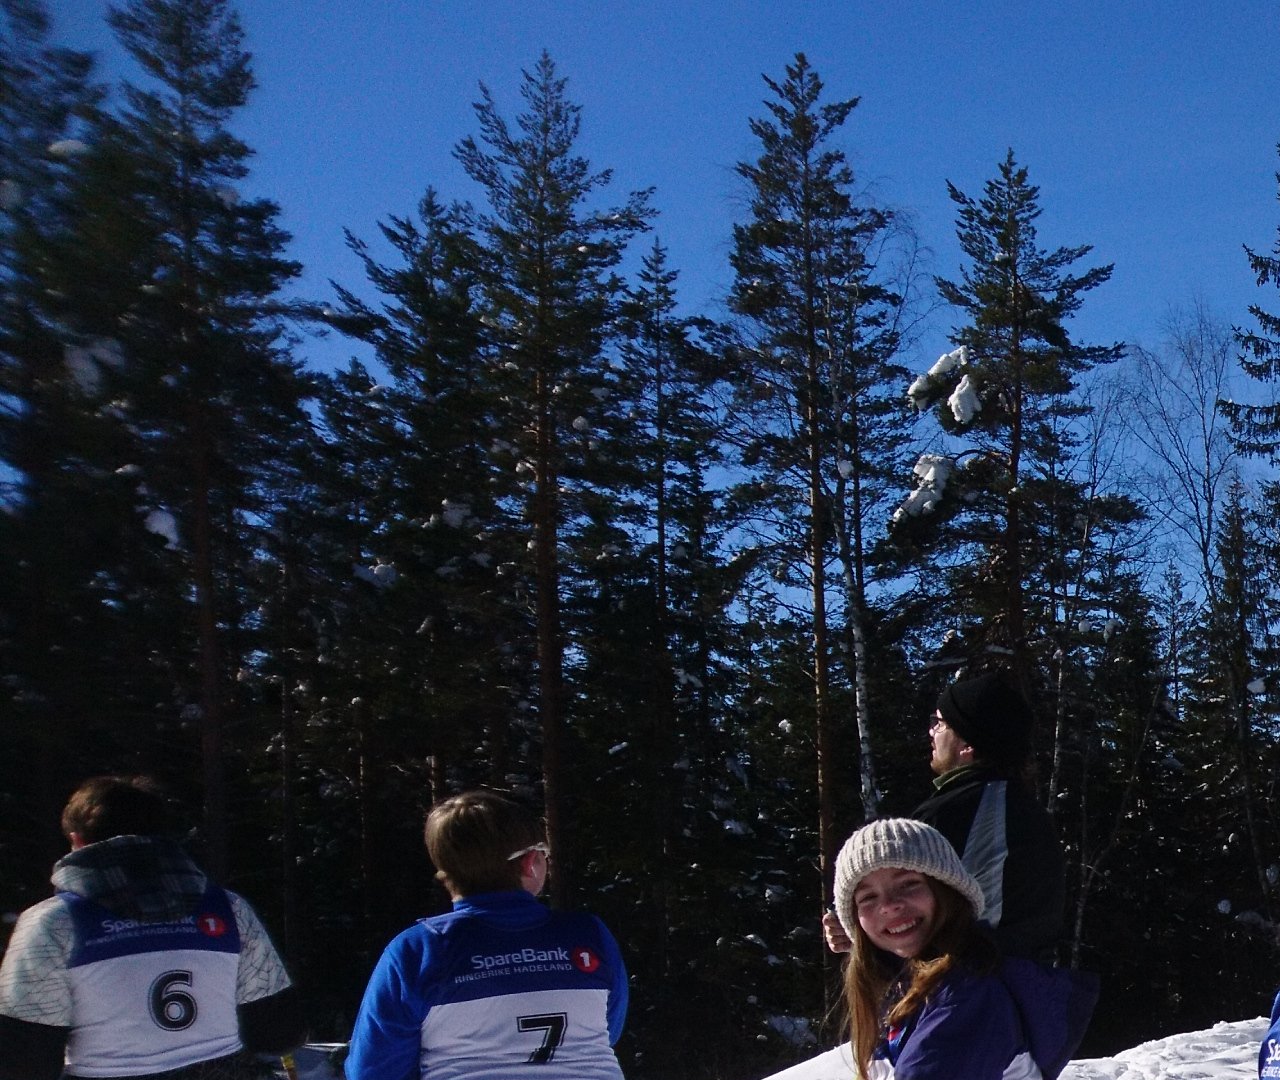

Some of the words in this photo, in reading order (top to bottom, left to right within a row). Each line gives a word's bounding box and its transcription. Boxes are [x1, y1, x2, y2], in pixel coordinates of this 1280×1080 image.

[455, 968, 511, 984] RINGERIKE
[514, 964, 572, 973] HADELAND
[471, 947, 570, 970] SpareBank
[148, 969, 198, 1032] 6
[517, 1012, 568, 1064] 7
